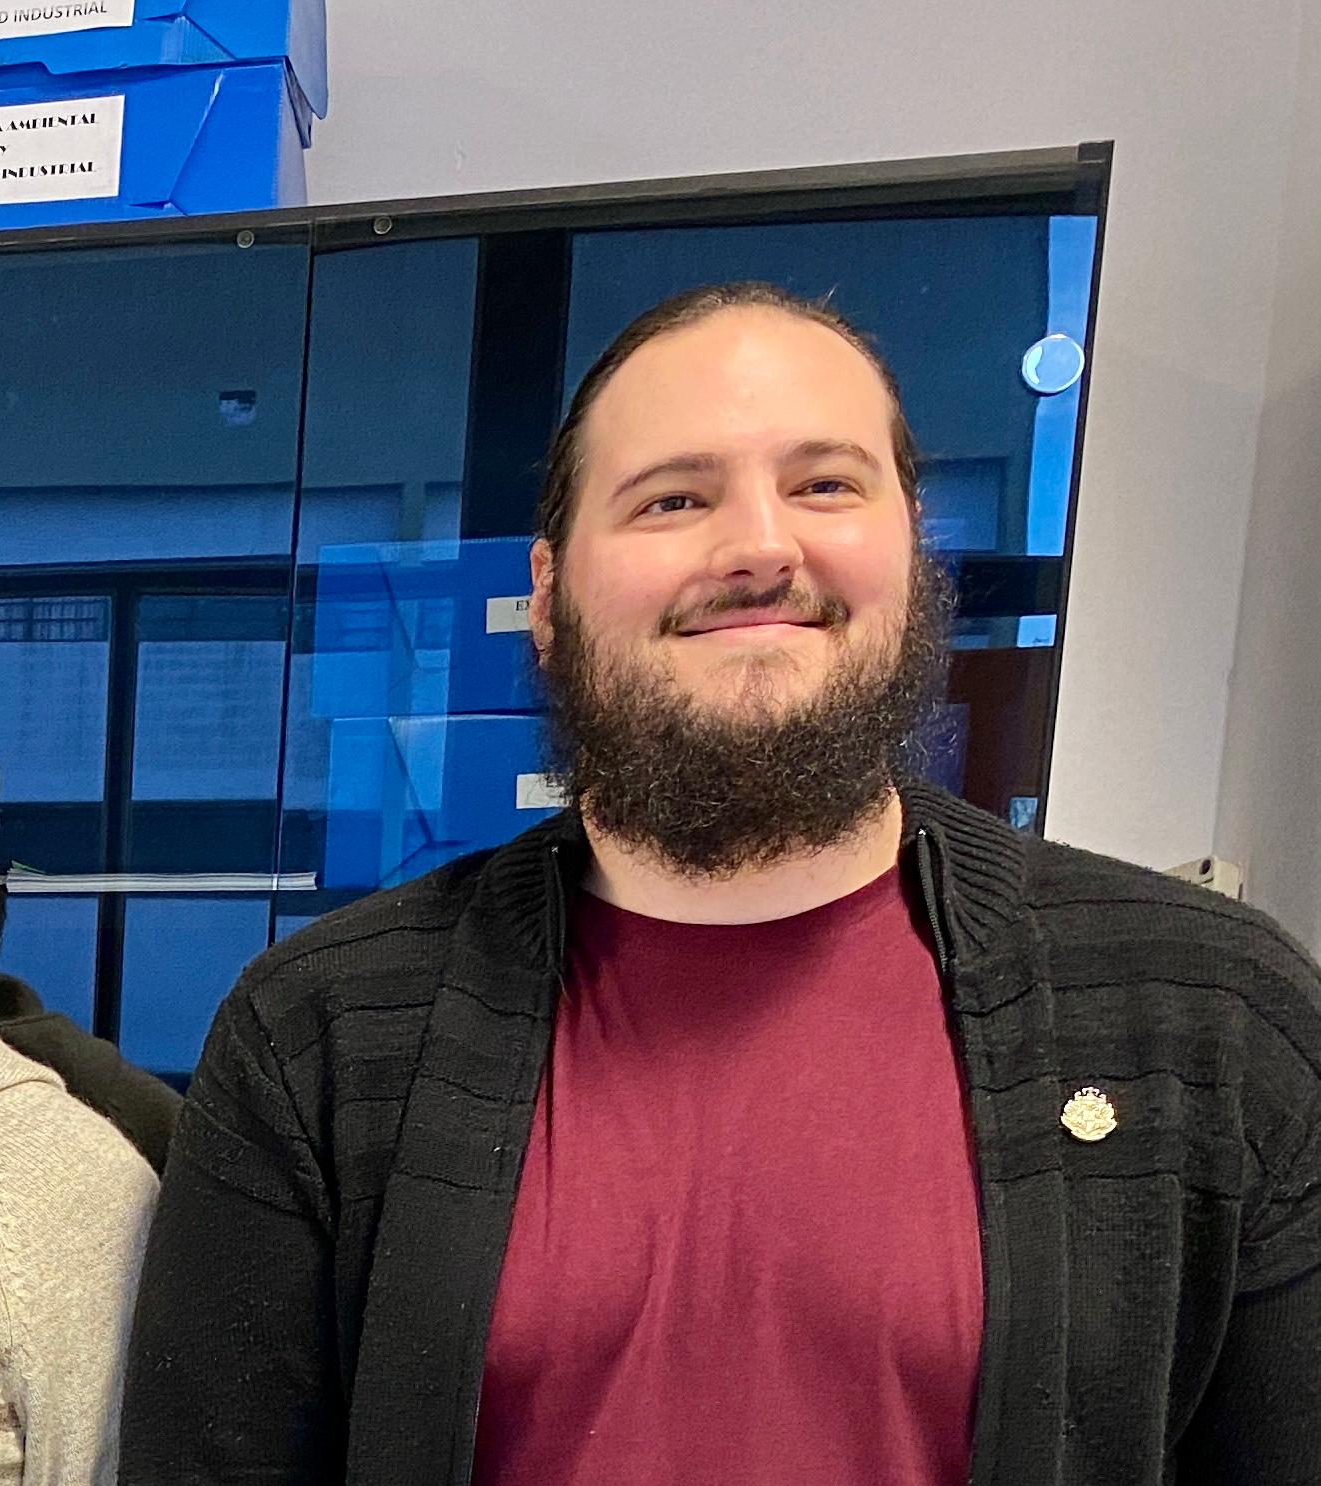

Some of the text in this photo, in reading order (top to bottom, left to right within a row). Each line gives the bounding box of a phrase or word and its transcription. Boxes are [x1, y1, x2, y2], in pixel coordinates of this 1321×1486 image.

[14, 0, 108, 23] INDUSTRIAL
[7, 113, 99, 131] AMBIENTAL
[0, 144, 9, 156] Y
[2, 161, 97, 180] INDUSTRIAL
